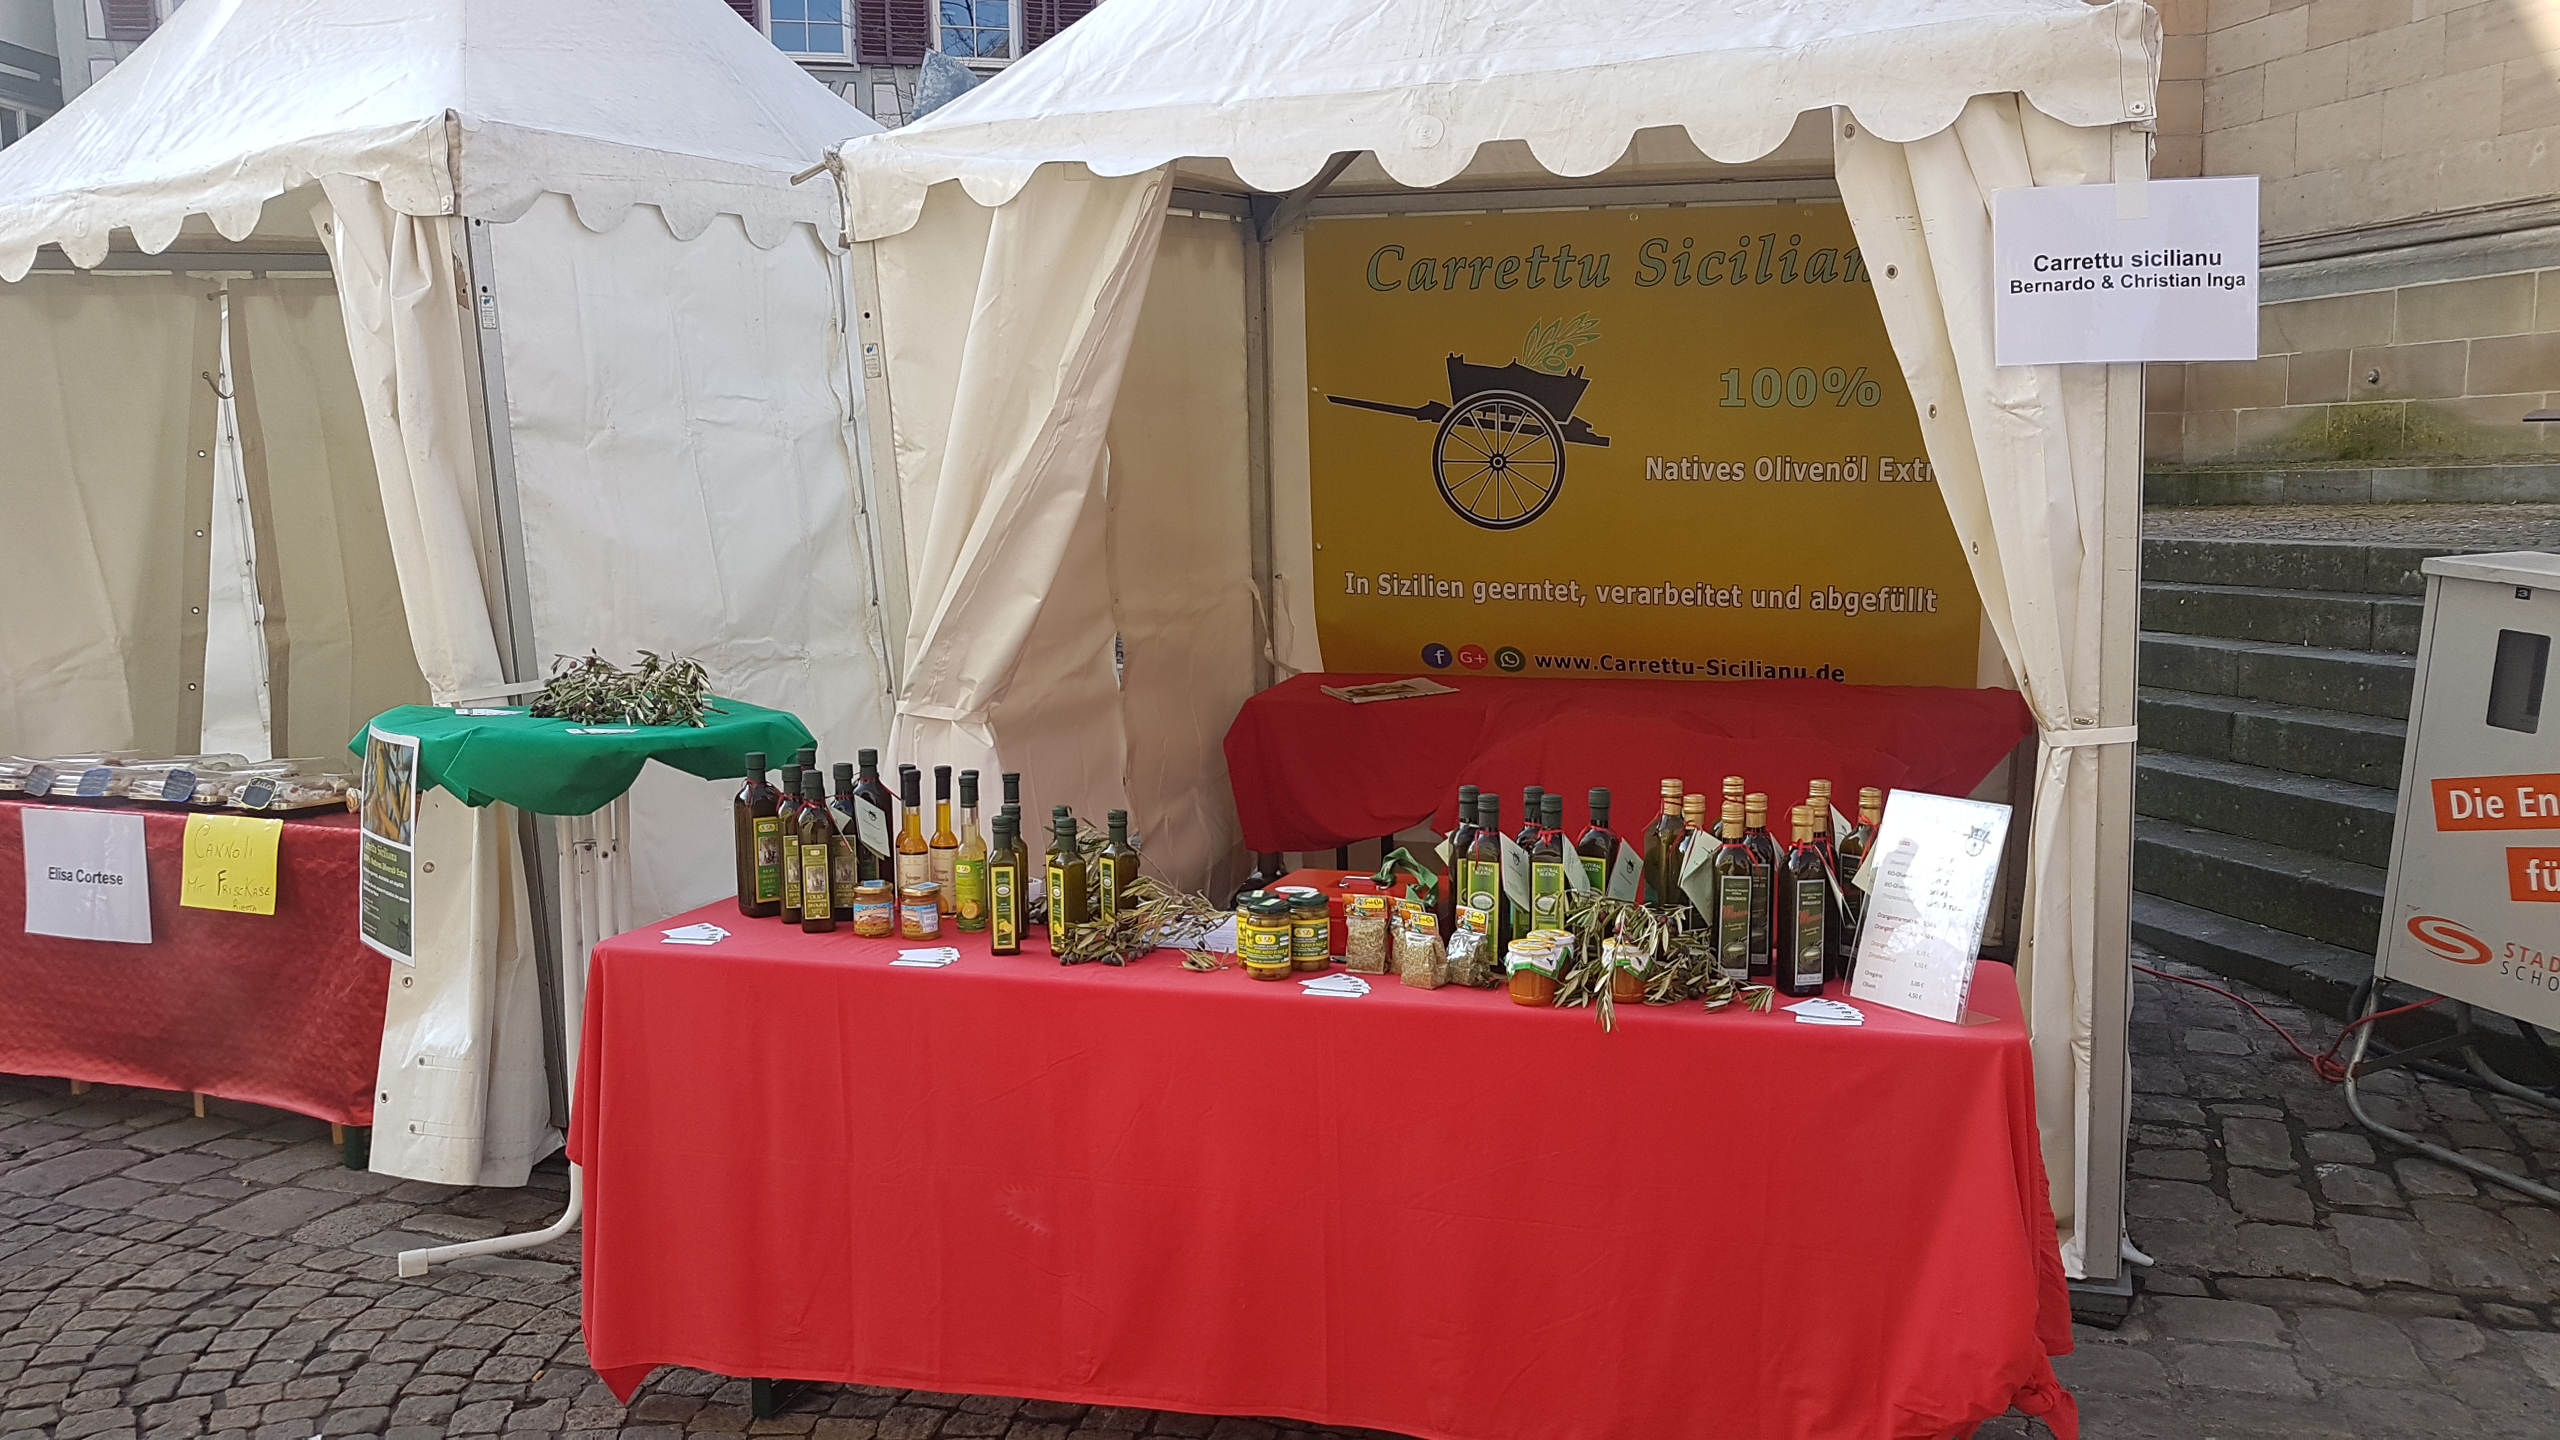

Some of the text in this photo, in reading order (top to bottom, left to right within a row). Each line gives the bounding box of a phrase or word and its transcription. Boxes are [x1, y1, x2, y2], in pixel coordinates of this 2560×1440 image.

[1366, 232, 1872, 292] Carrettu Sicilian
[2033, 249, 2222, 272] Carrettu sicilianu
[2010, 272, 2246, 294] Bernardo & Christian Inga
[1718, 366, 1882, 409] 100%
[1645, 455, 1933, 482] Natives Olivenöl Extr
[1344, 571, 1938, 618] In Sizilien geerntet, verarbeitet und abgefüllt
[1533, 654, 1846, 683] www.Carrettu-Sicilianu.de
[2449, 786, 2560, 820] Die En
[48, 867, 124, 886] Elisa Cortese
[2525, 858, 2560, 892] fü
[2504, 941, 2560, 973] STAD
[2500, 960, 2560, 991] SCHO
